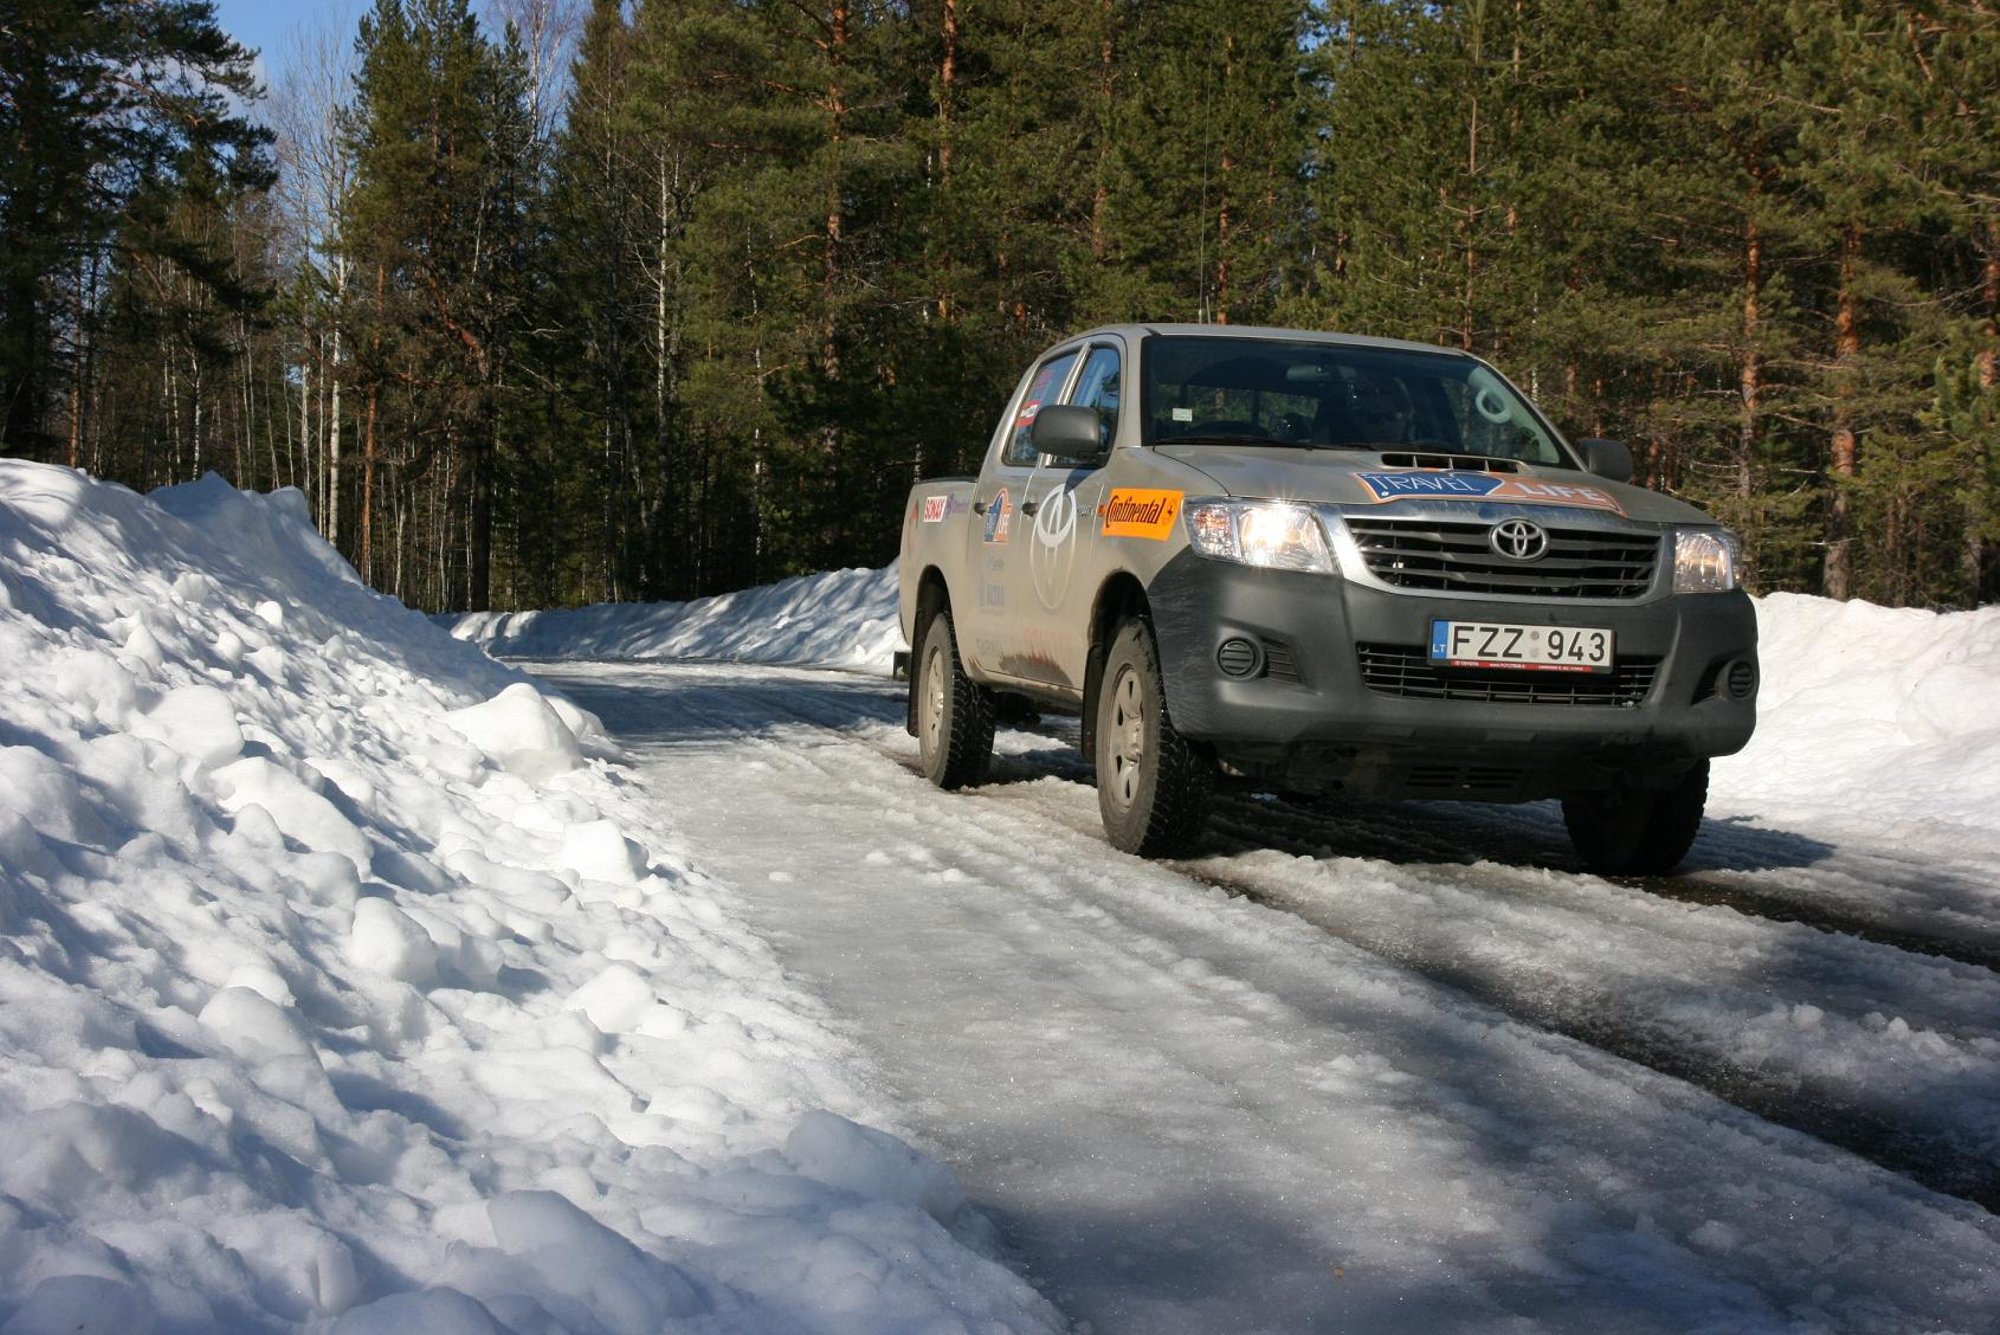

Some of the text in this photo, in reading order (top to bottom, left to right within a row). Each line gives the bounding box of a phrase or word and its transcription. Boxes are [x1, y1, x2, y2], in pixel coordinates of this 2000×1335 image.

[1366, 475, 1604, 501] TRAVEL LIFE
[1105, 494, 1167, 528] Continental
[1432, 643, 1447, 653] LT
[1452, 625, 1605, 662] FZZ 943
